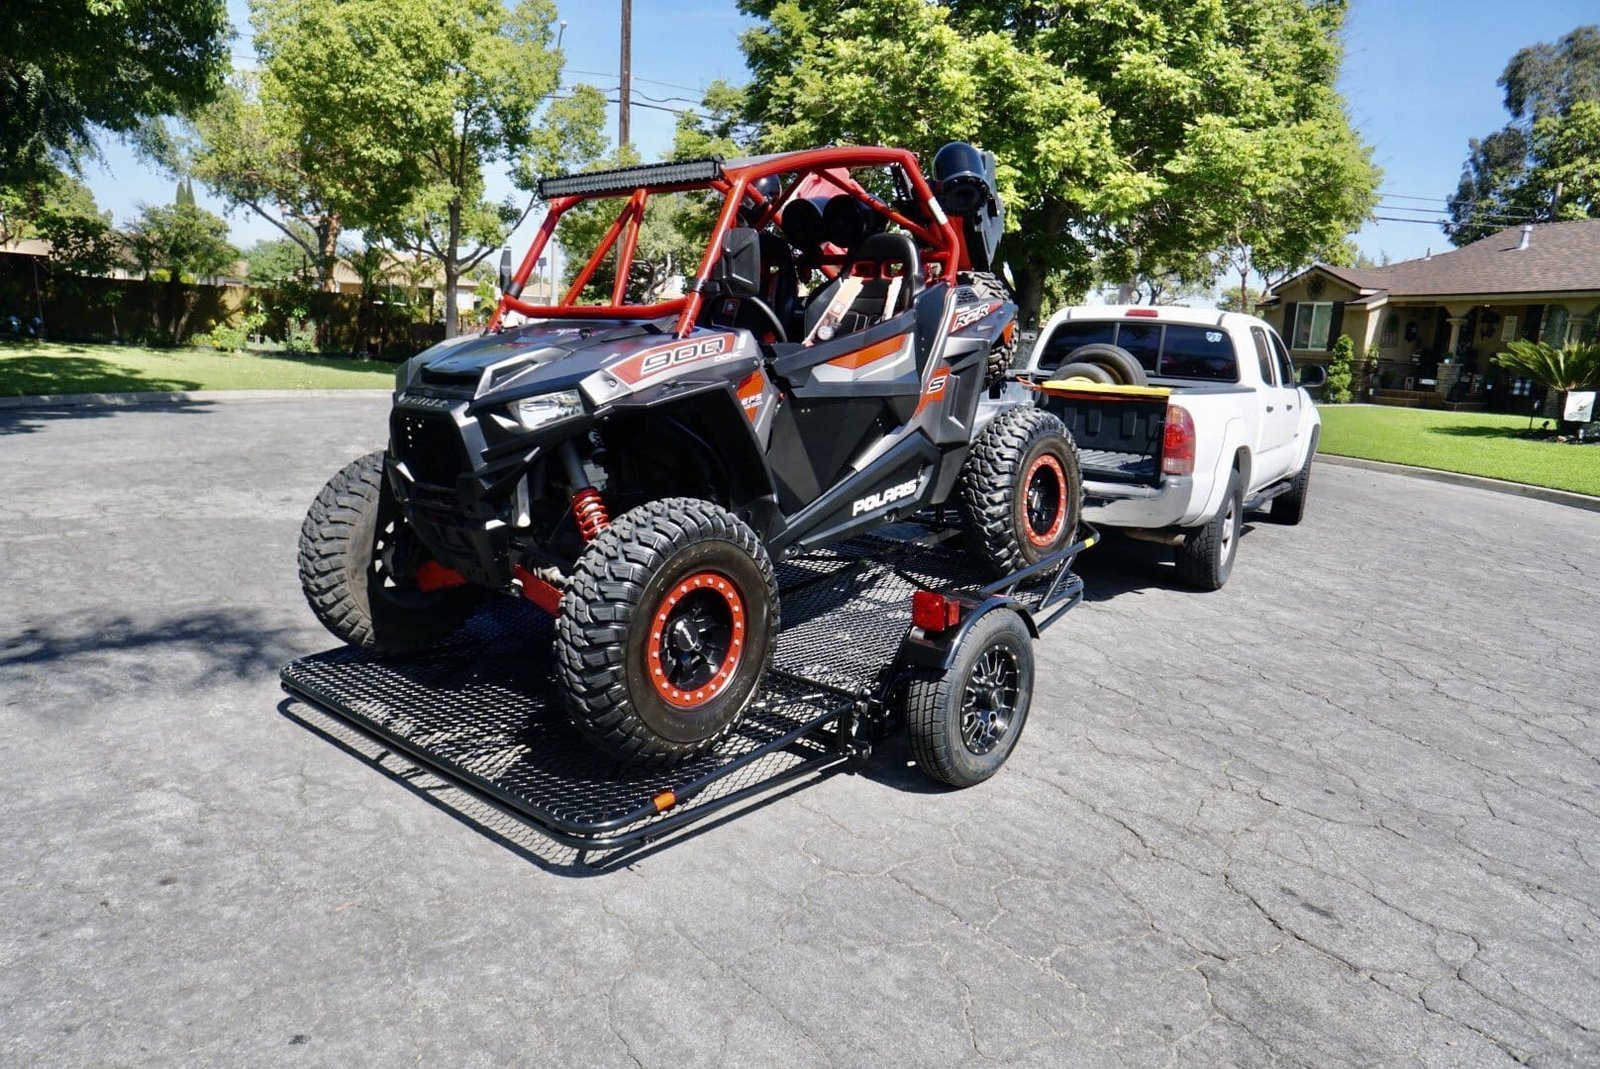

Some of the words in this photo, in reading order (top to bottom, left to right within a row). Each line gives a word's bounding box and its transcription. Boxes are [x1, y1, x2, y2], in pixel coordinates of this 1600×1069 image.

[951, 303, 990, 332] RZR
[641, 337, 725, 375] 900
[741, 393, 762, 405] EPS
[852, 479, 917, 517] POLARIS
